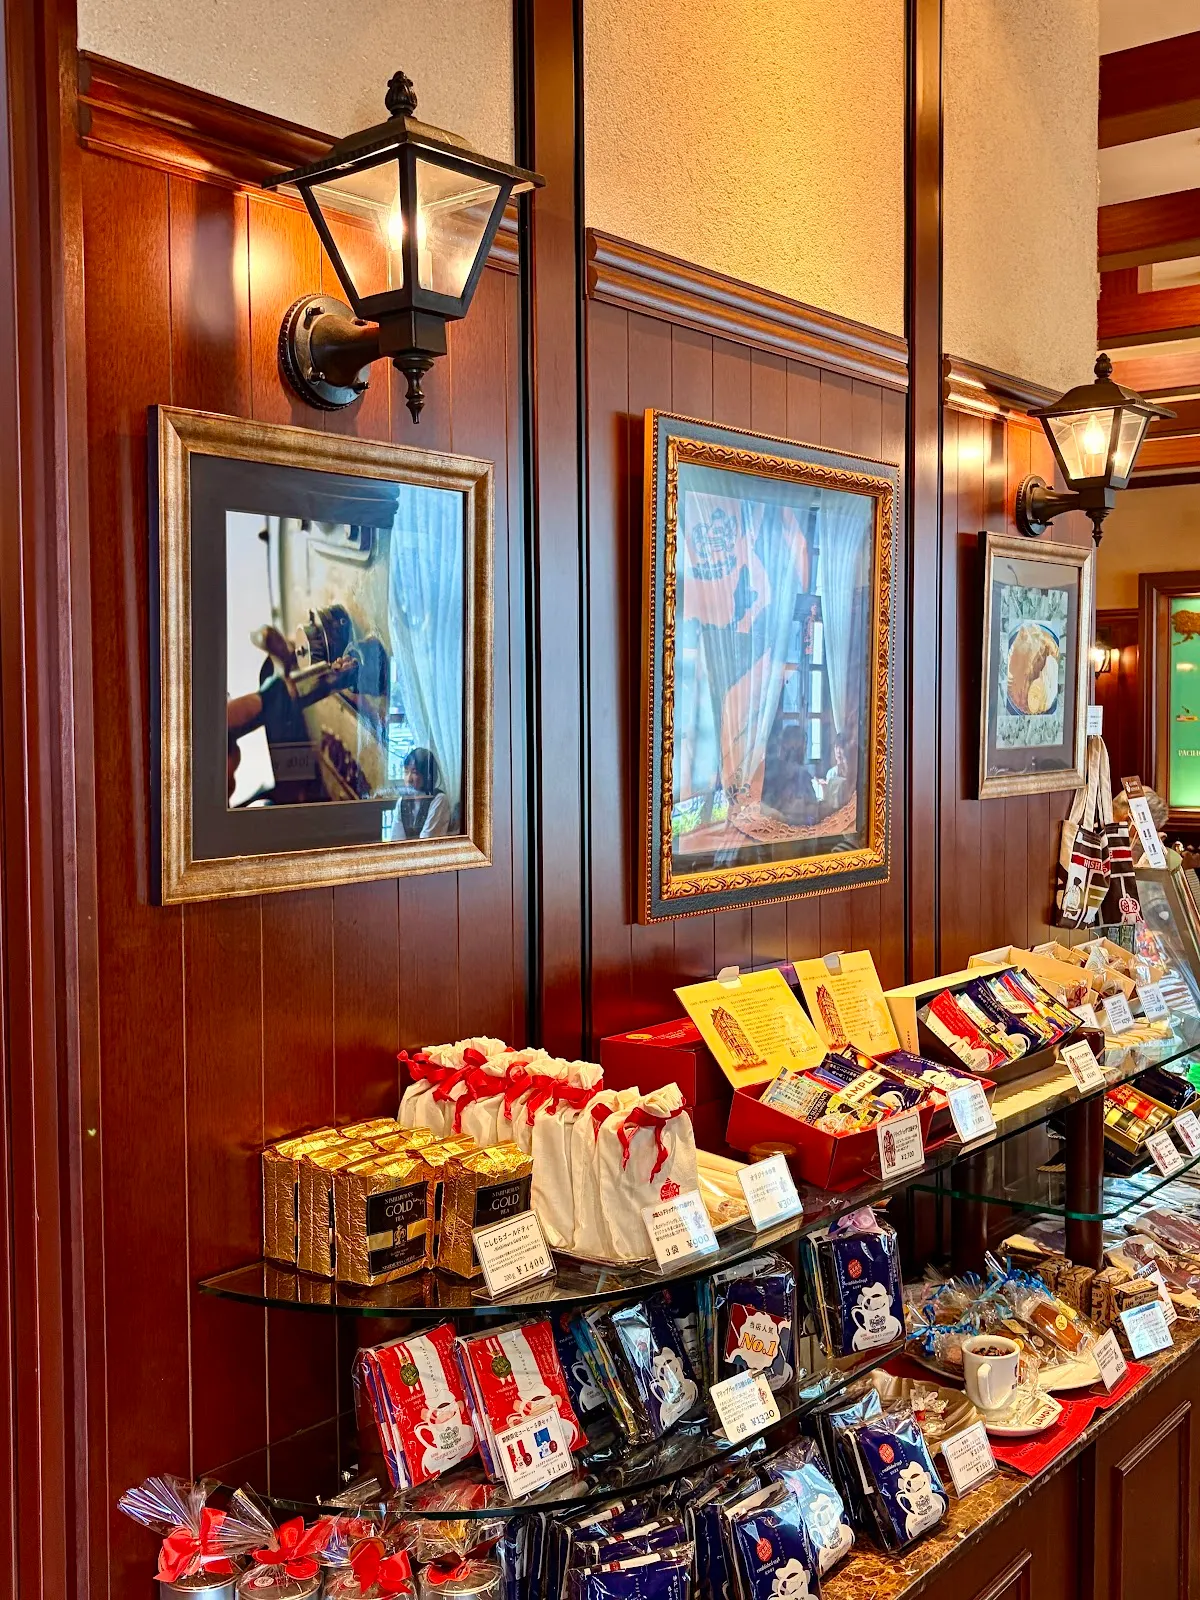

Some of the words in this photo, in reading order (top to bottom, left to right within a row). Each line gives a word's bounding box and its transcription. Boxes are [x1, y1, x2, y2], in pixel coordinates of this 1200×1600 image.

[385, 1200, 414, 1218] GOLD
[491, 1193, 520, 1211] GOLD
[483, 1223, 534, 1249] にしむらゴールドティー
[686, 1233, 710, 1249] ¥900
[516, 1256, 545, 1275] ¥1400
[749, 1321, 774, 1335] 当店人気
[739, 1331, 777, 1357] No.1
[750, 1409, 775, 1426] ¥1320
